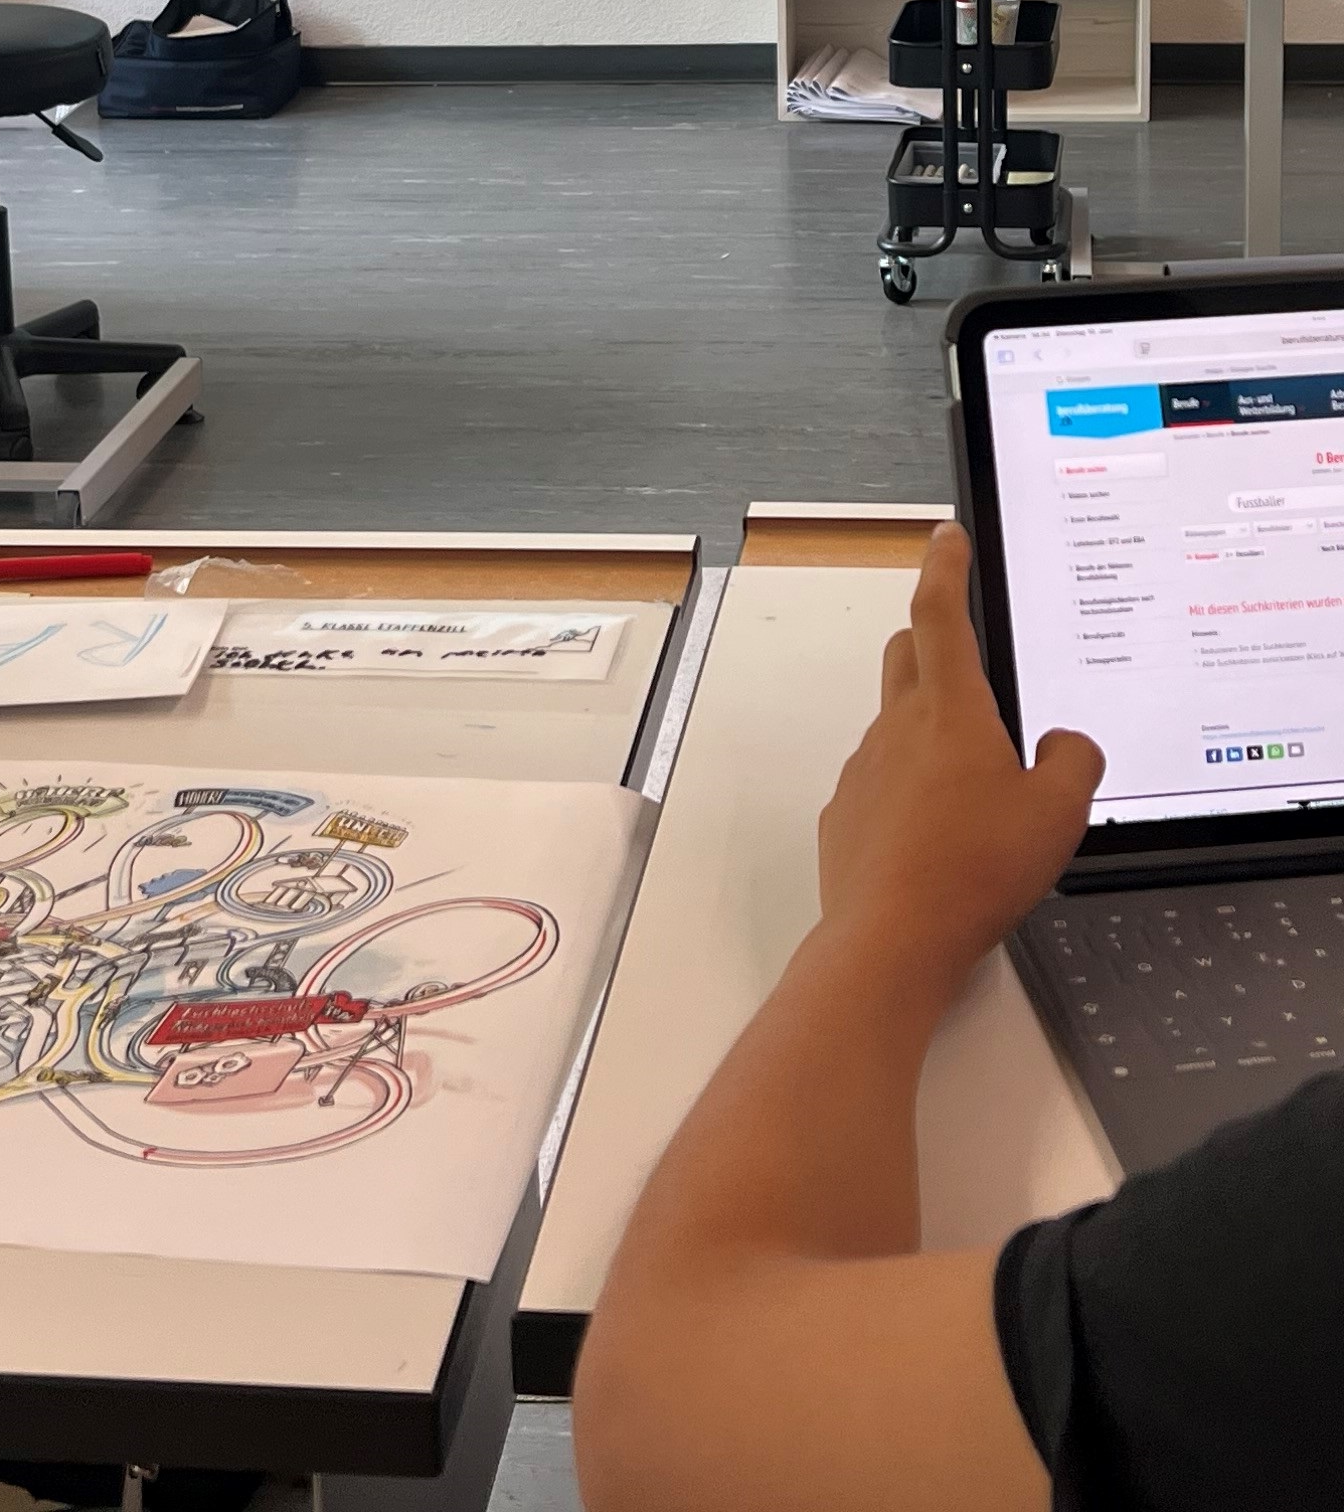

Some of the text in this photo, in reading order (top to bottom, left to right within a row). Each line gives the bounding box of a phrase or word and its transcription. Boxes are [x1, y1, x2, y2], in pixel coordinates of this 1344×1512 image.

[1189, 604, 1205, 616] Mit
[1208, 602, 1239, 615] diesen
[1241, 598, 1304, 613] Suchkriterien
[1306, 596, 1342, 609] wurden
